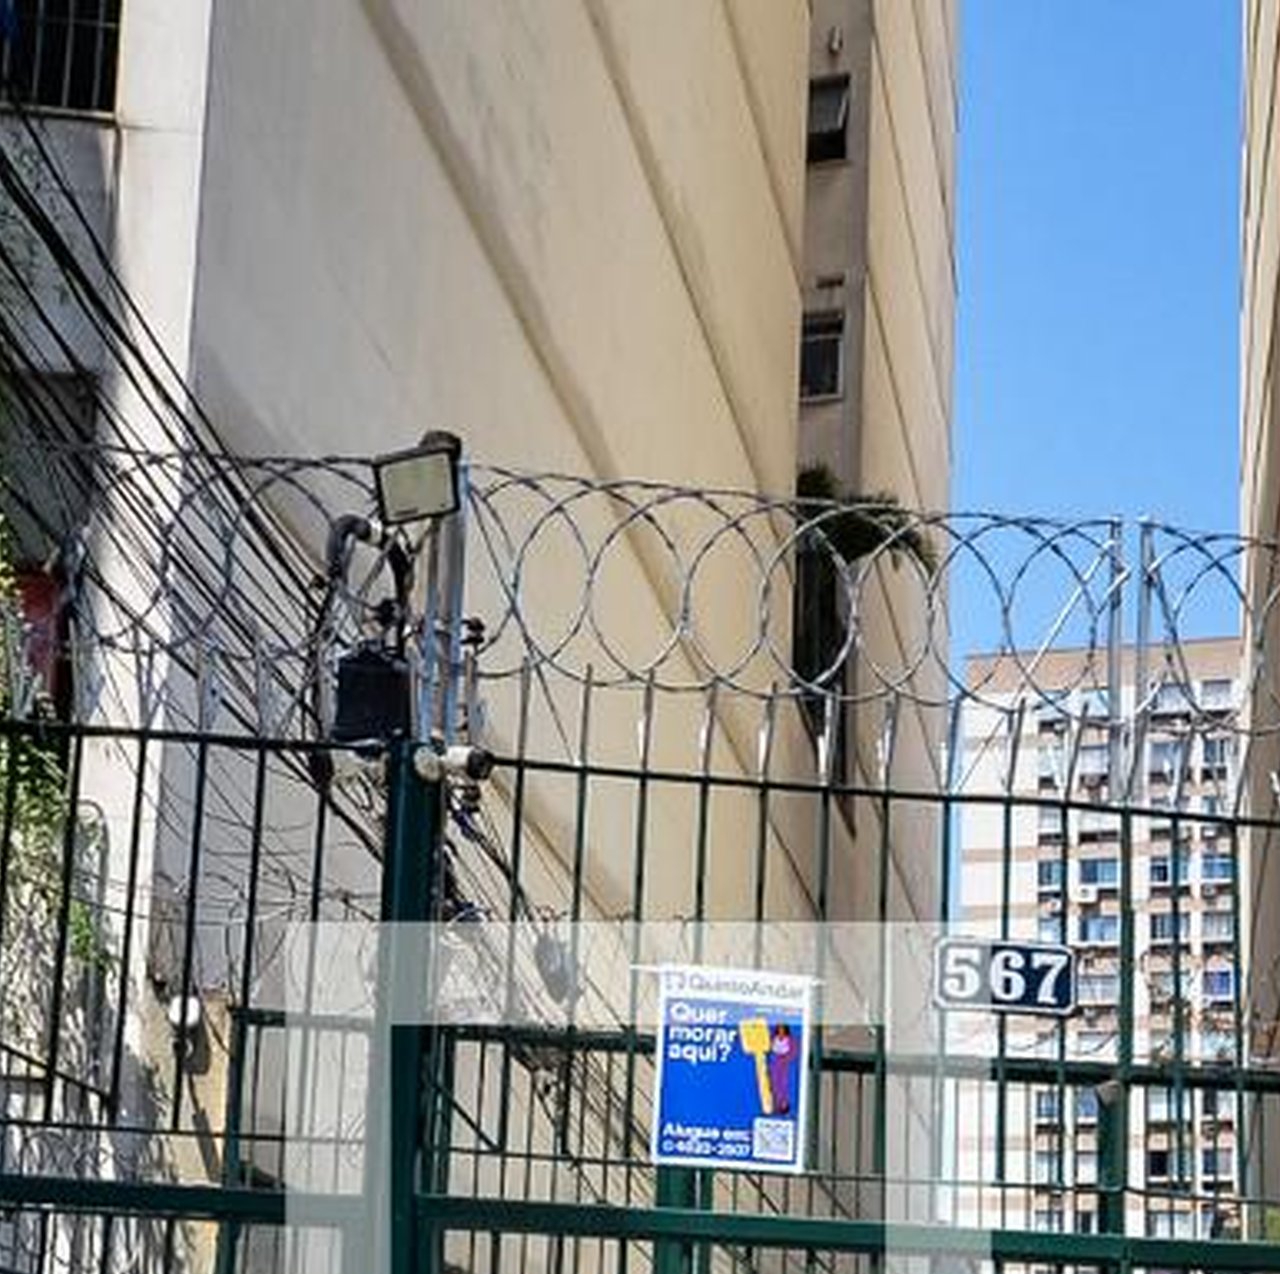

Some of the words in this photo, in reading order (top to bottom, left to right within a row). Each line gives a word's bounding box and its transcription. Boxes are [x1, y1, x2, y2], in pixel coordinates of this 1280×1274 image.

[942, 947, 1068, 1004] 567
[670, 1002, 729, 1024] Quer
[668, 1025, 737, 1043] morar
[668, 1042, 732, 1065] aqui?
